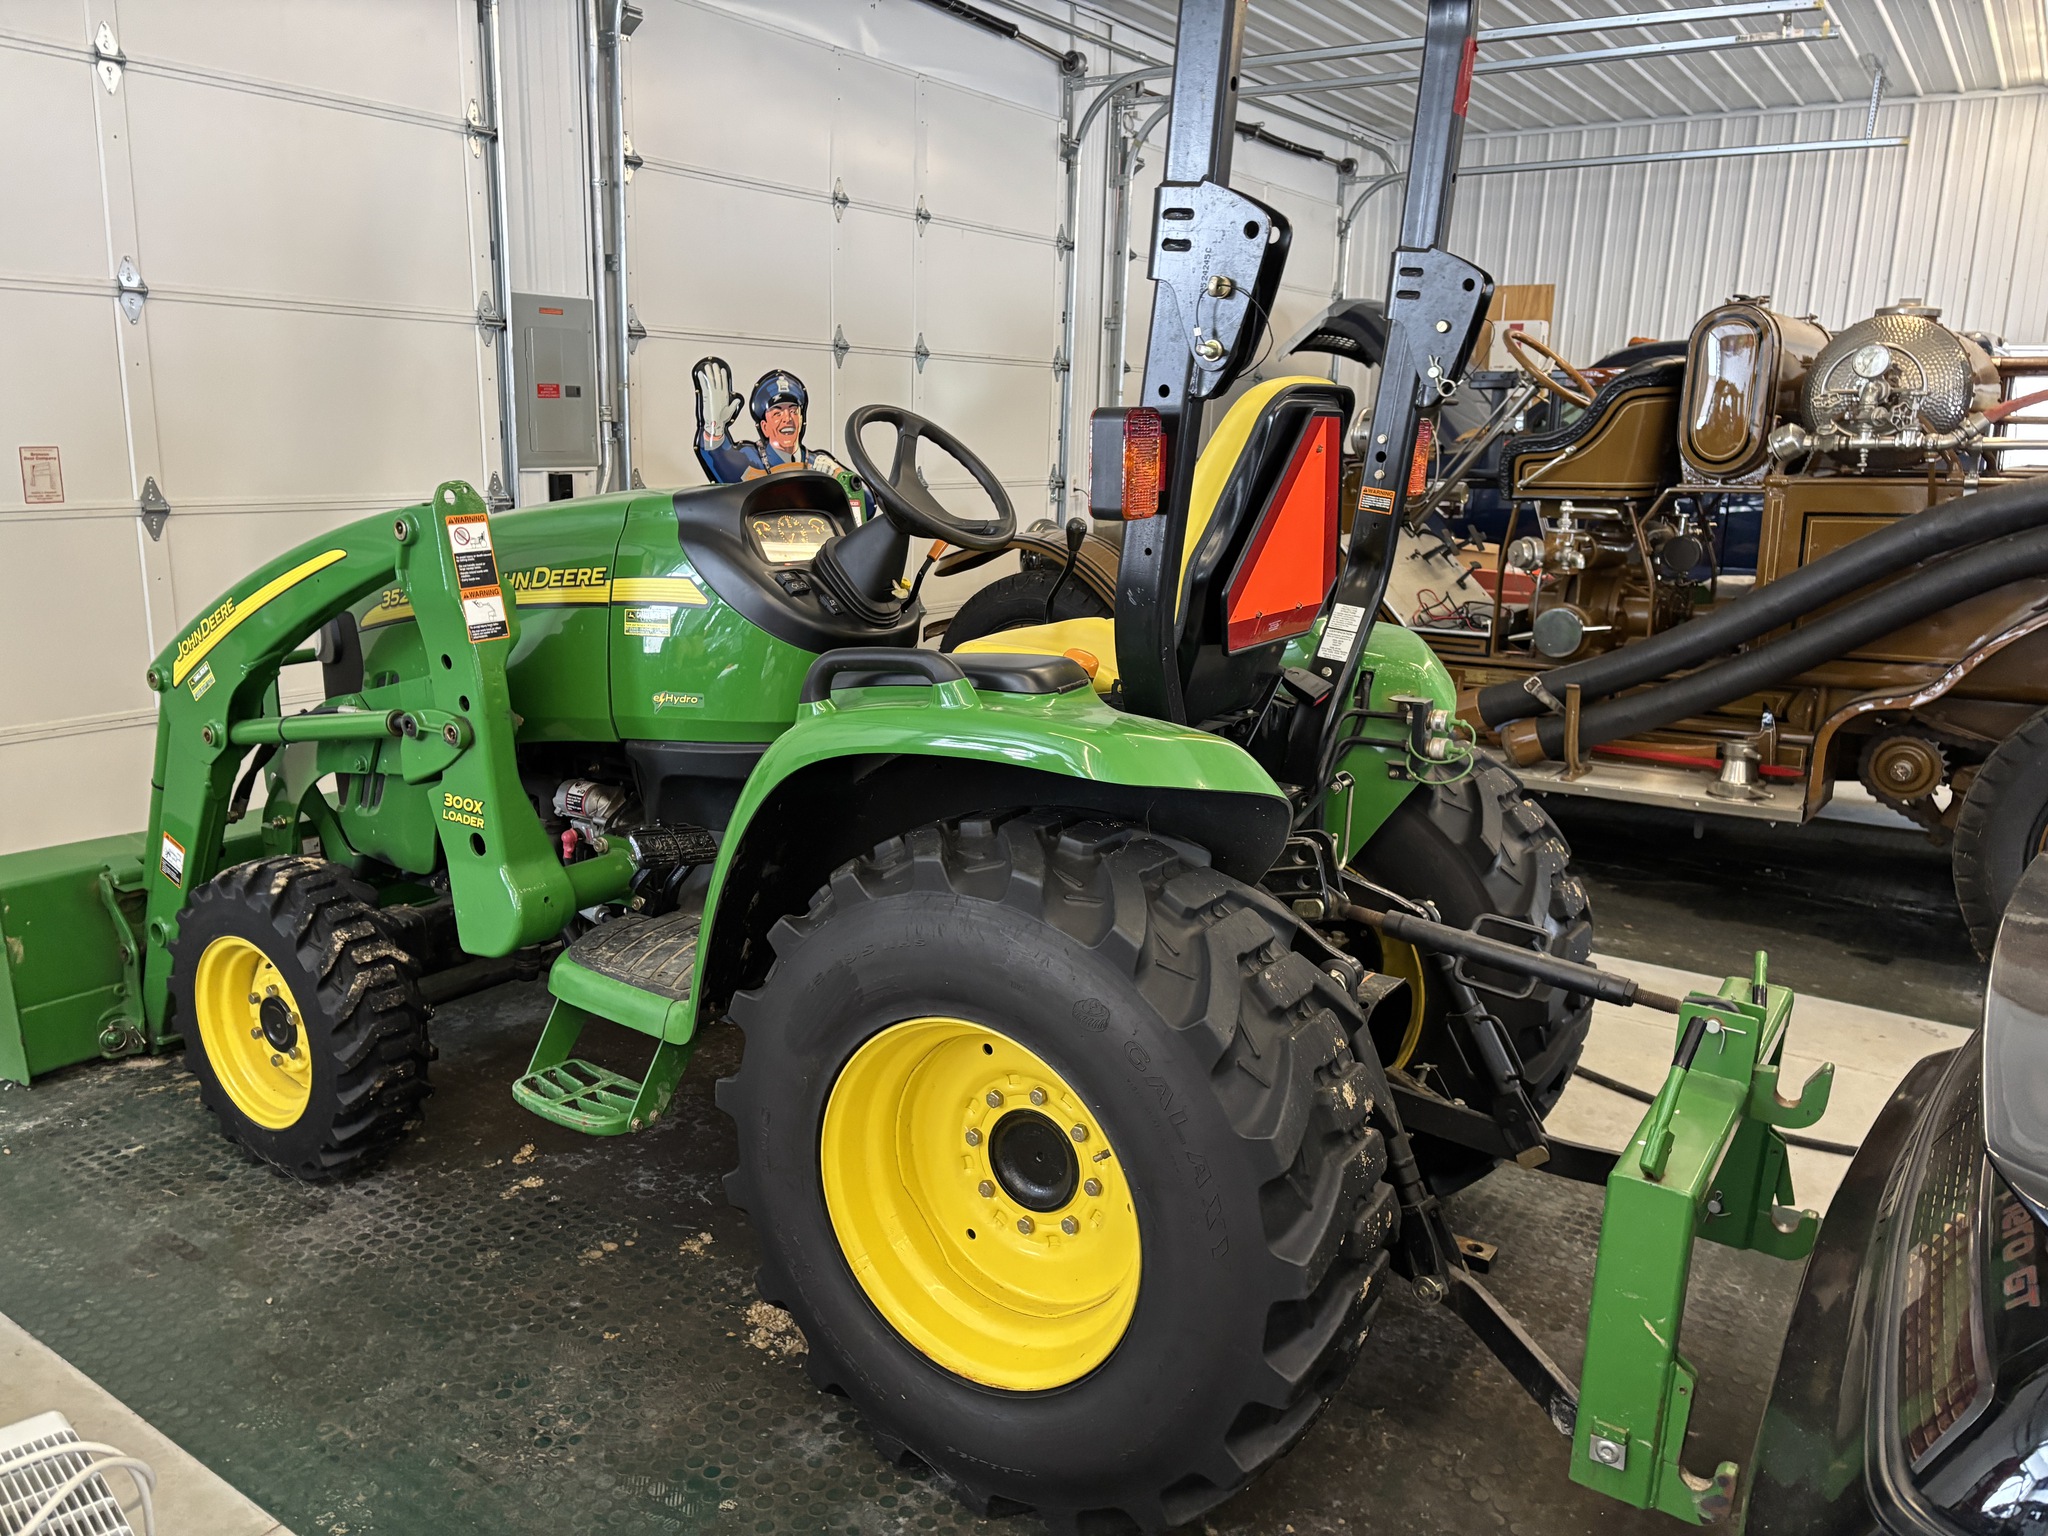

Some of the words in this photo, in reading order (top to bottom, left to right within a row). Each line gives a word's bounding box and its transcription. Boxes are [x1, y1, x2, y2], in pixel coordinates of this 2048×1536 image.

[1367, 488, 1394, 498] WARNING
[453, 514, 486, 524] WARNING
[531, 566, 606, 588] DEERE
[468, 588, 500, 599] WARNING
[176, 628, 203, 662] JOHN
[200, 597, 236, 637] DEERE
[443, 792, 485, 815] 300X
[442, 808, 485, 830] LOADER
[2003, 1264, 2041, 1311] GT
